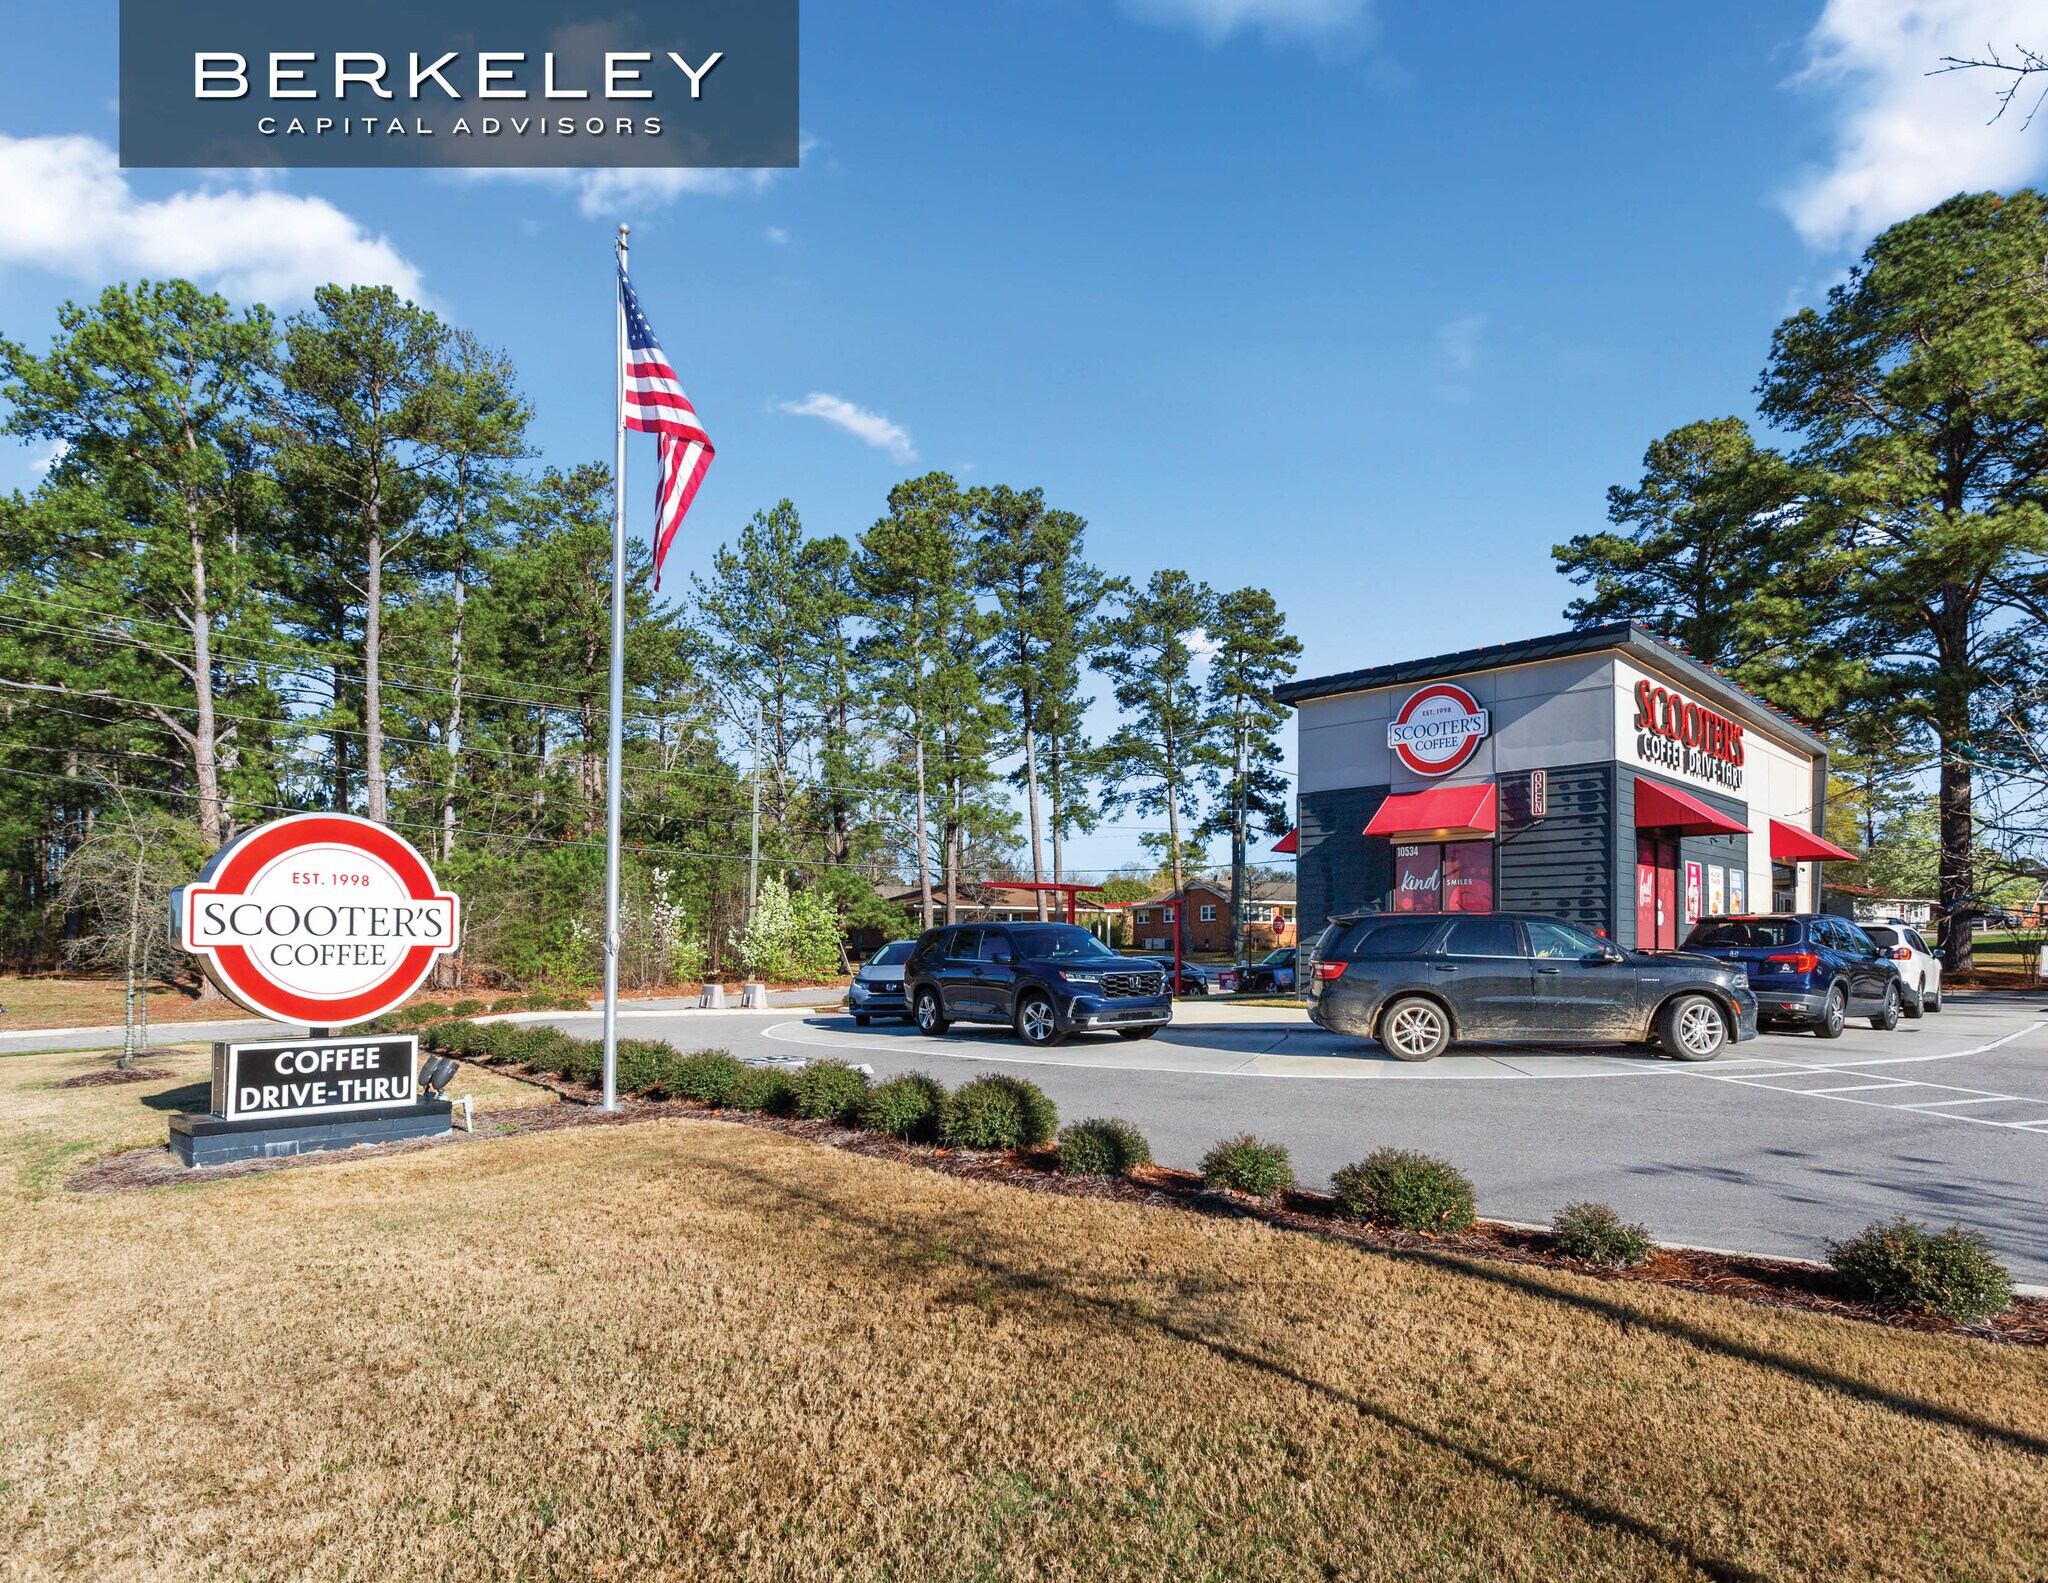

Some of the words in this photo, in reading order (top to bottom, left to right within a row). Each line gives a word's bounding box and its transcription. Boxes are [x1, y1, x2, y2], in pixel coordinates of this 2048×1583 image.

[1436, 706, 1452, 714] 1998
[1393, 716, 1482, 742] SCOOTER'S
[1637, 679, 1745, 768] SCOOTER'S
[1415, 736, 1459, 752] COFFEE
[1397, 846, 1419, 857] 10534
[292, 872, 325, 886] EST.
[332, 874, 370, 887] 1998
[1446, 878, 1473, 886] SMILES
[203, 903, 443, 938] SCOOTER'S
[270, 943, 387, 967] COFFEE
[274, 1046, 381, 1076] COFFEE
[239, 1074, 411, 1112] DRIVE-THRU
